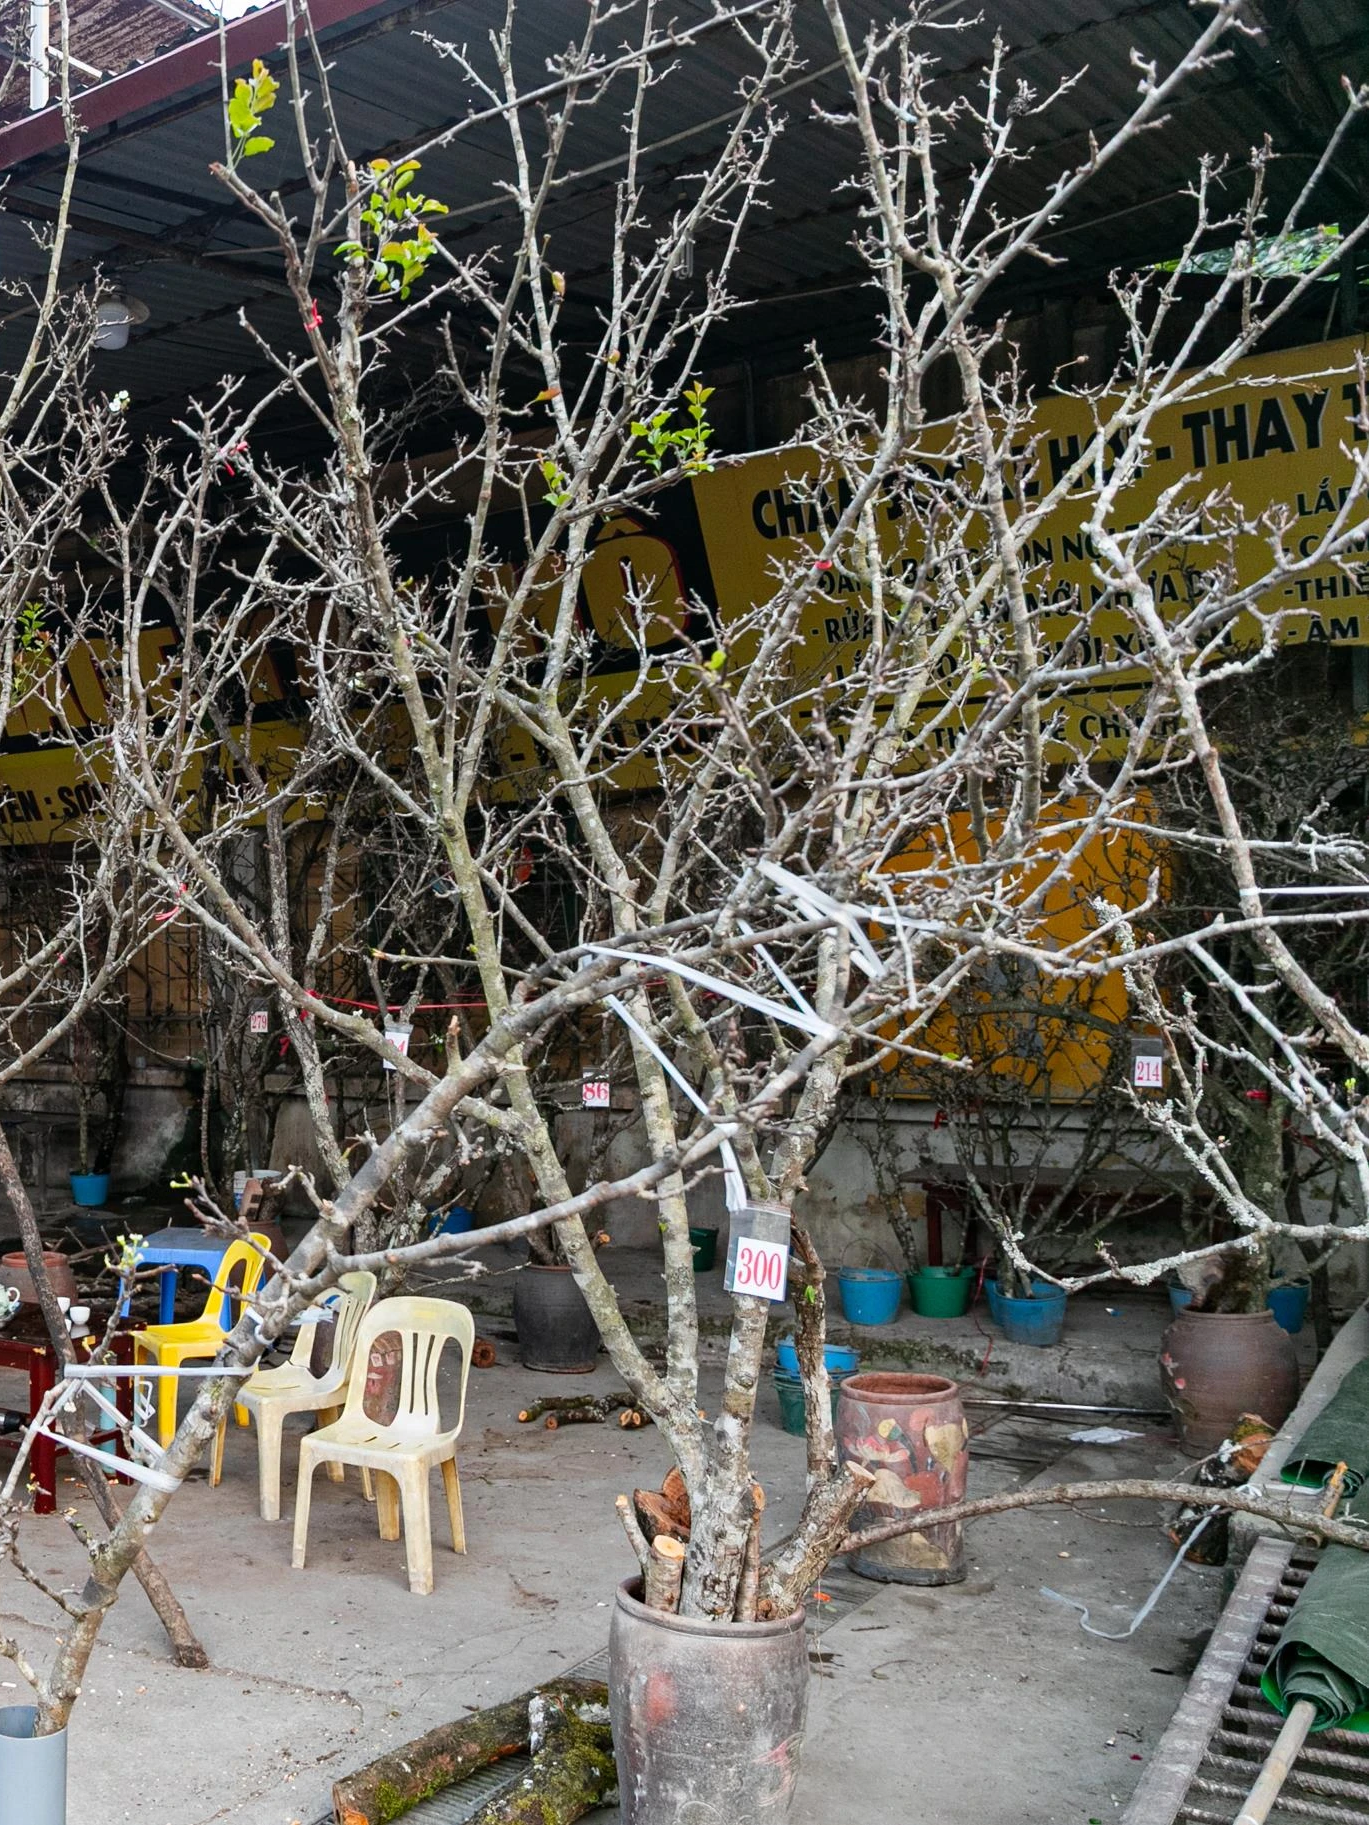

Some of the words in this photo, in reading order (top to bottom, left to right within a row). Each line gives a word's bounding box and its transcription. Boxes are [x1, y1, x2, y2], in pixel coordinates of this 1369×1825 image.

[1182, 387, 1329, 468] THAY
[1136, 1060, 1161, 1082] 214
[737, 1247, 783, 1290] 300
